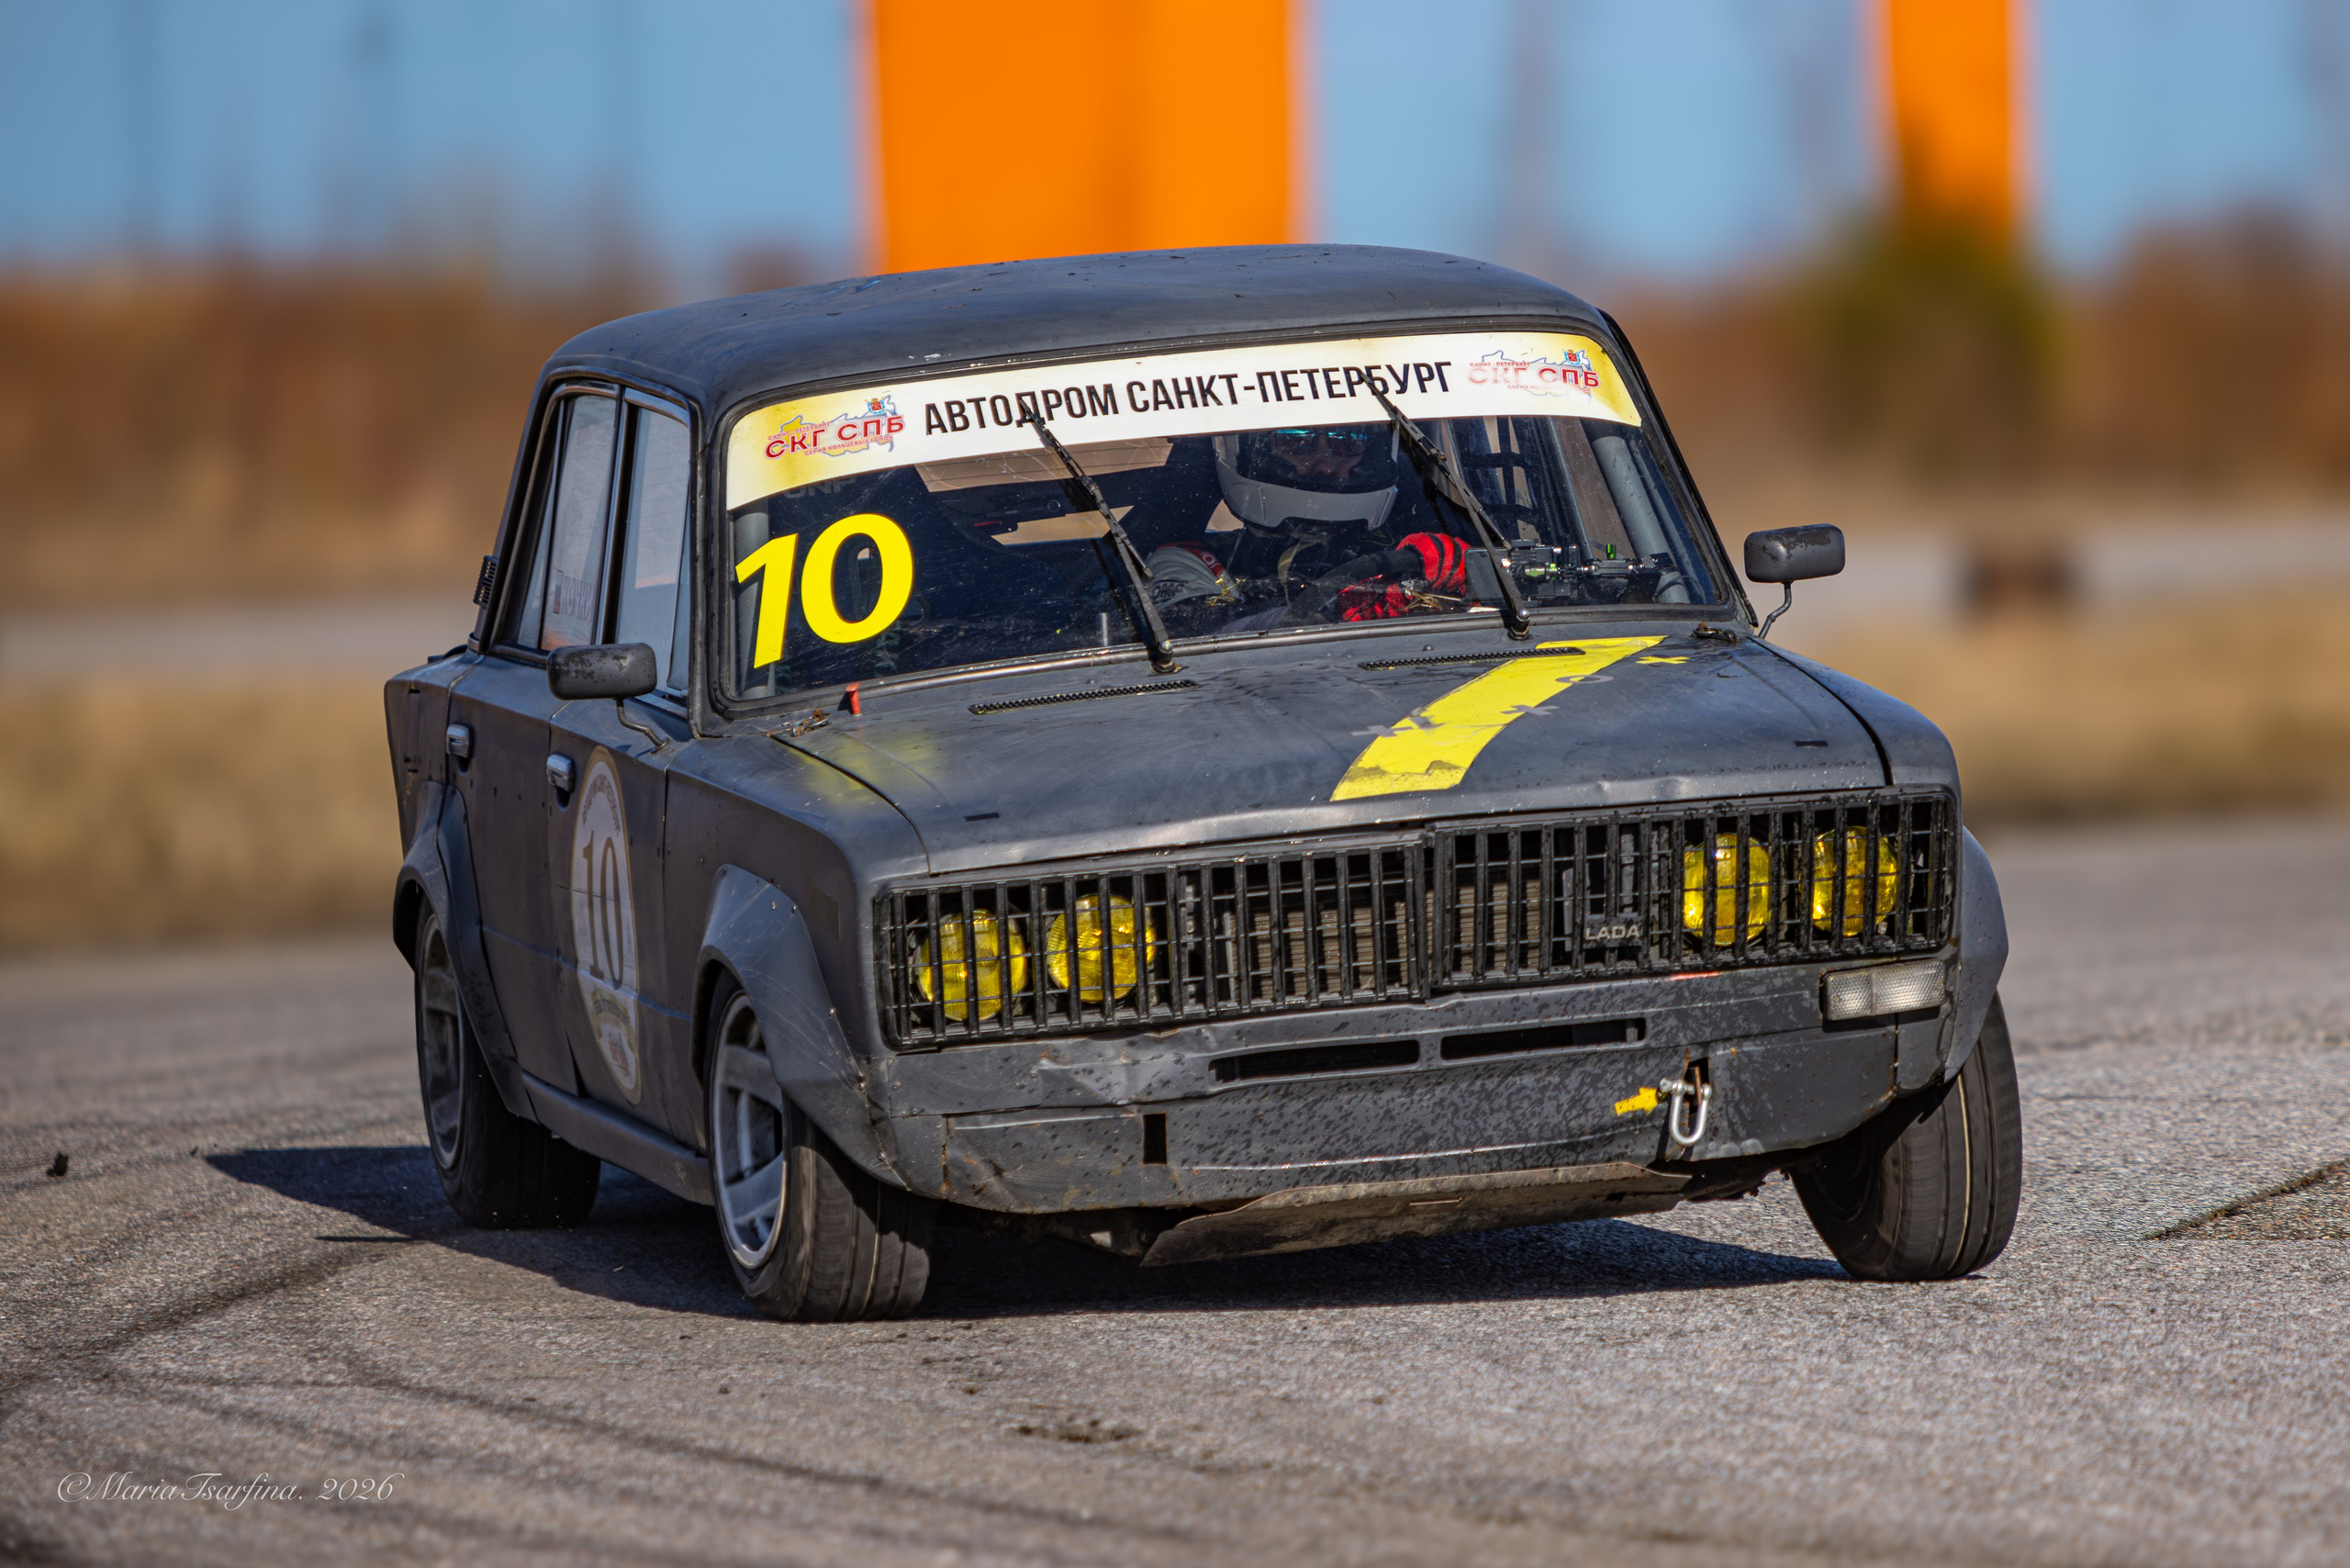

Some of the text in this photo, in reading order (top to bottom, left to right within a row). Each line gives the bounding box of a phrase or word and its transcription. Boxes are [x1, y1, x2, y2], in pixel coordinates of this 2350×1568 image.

[925, 361, 1452, 435] АВТОДРОМ САНКТ-ПЕТЕРБУРГ
[1467, 367, 1600, 387] СКГ СПБ
[764, 414, 905, 460] СКГ СПБ
[734, 513, 914, 669] 10
[583, 830, 623, 990] 10
[1584, 924, 1641, 941] LADA
